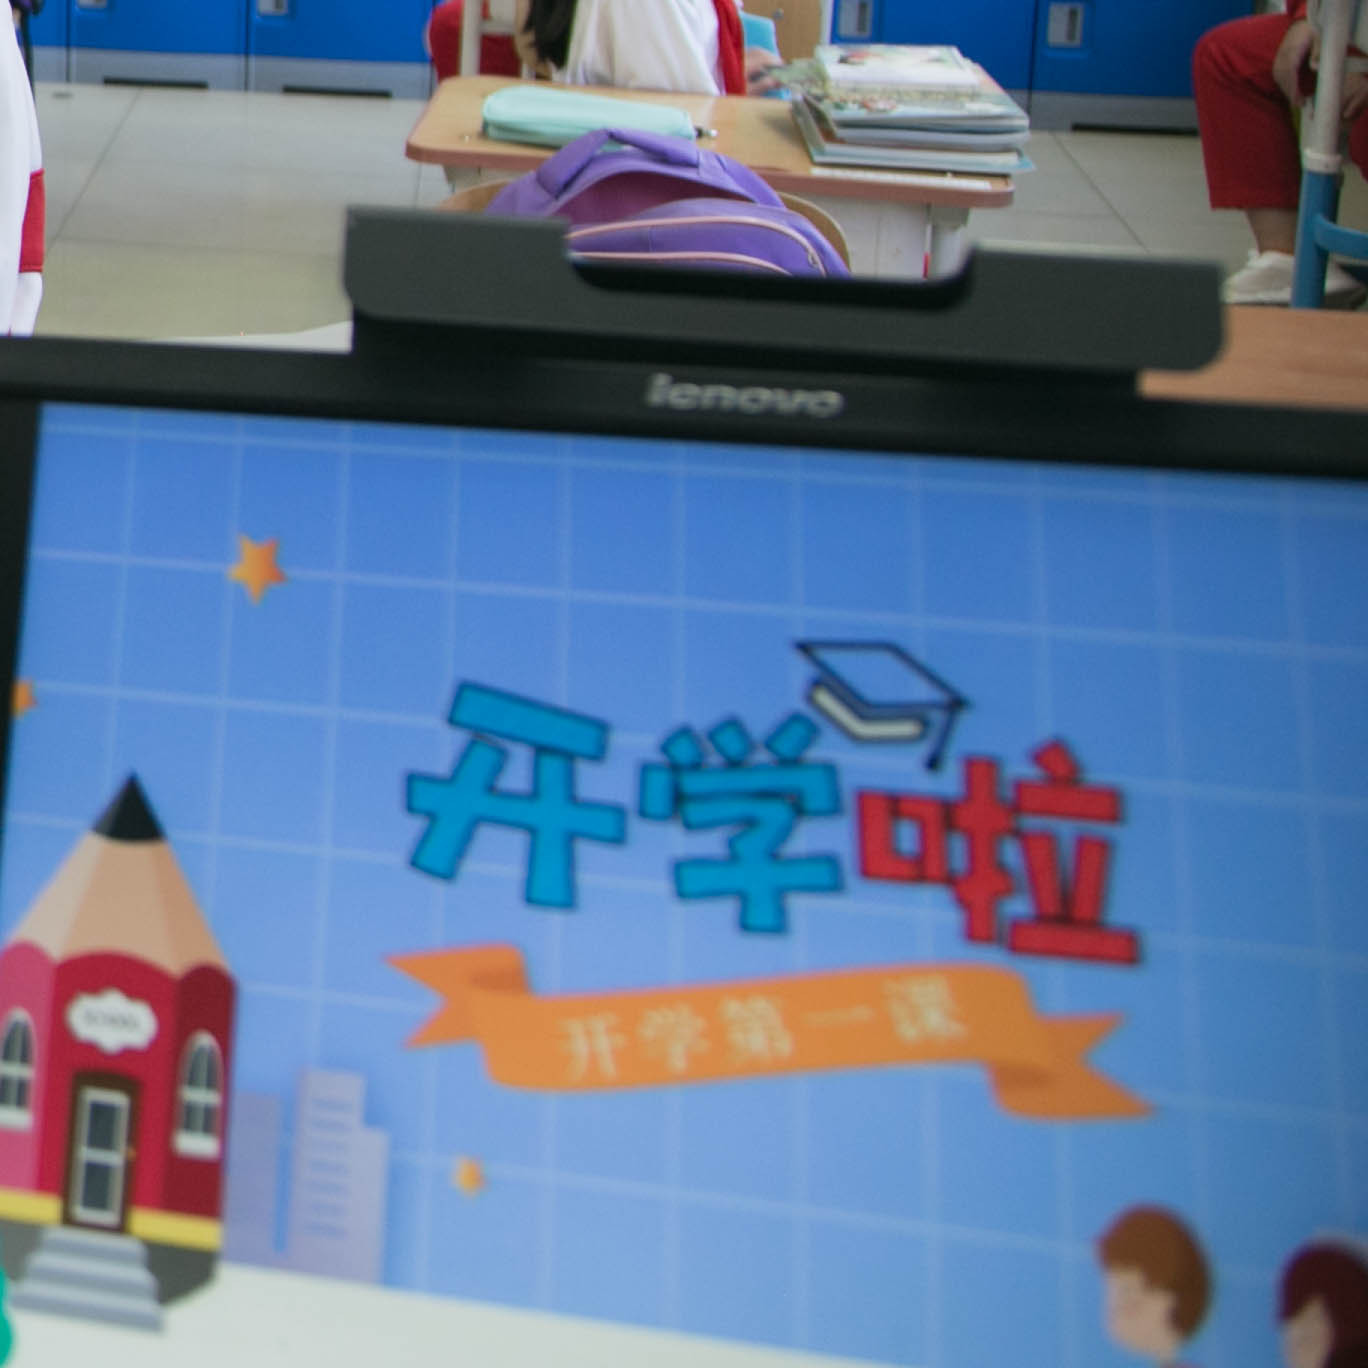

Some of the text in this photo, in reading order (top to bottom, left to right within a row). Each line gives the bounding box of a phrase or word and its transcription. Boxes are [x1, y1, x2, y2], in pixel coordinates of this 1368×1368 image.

[647, 372, 845, 419] lenovo
[404, 678, 1142, 966] 开学啦
[558, 973, 969, 1082] 开学第一课
